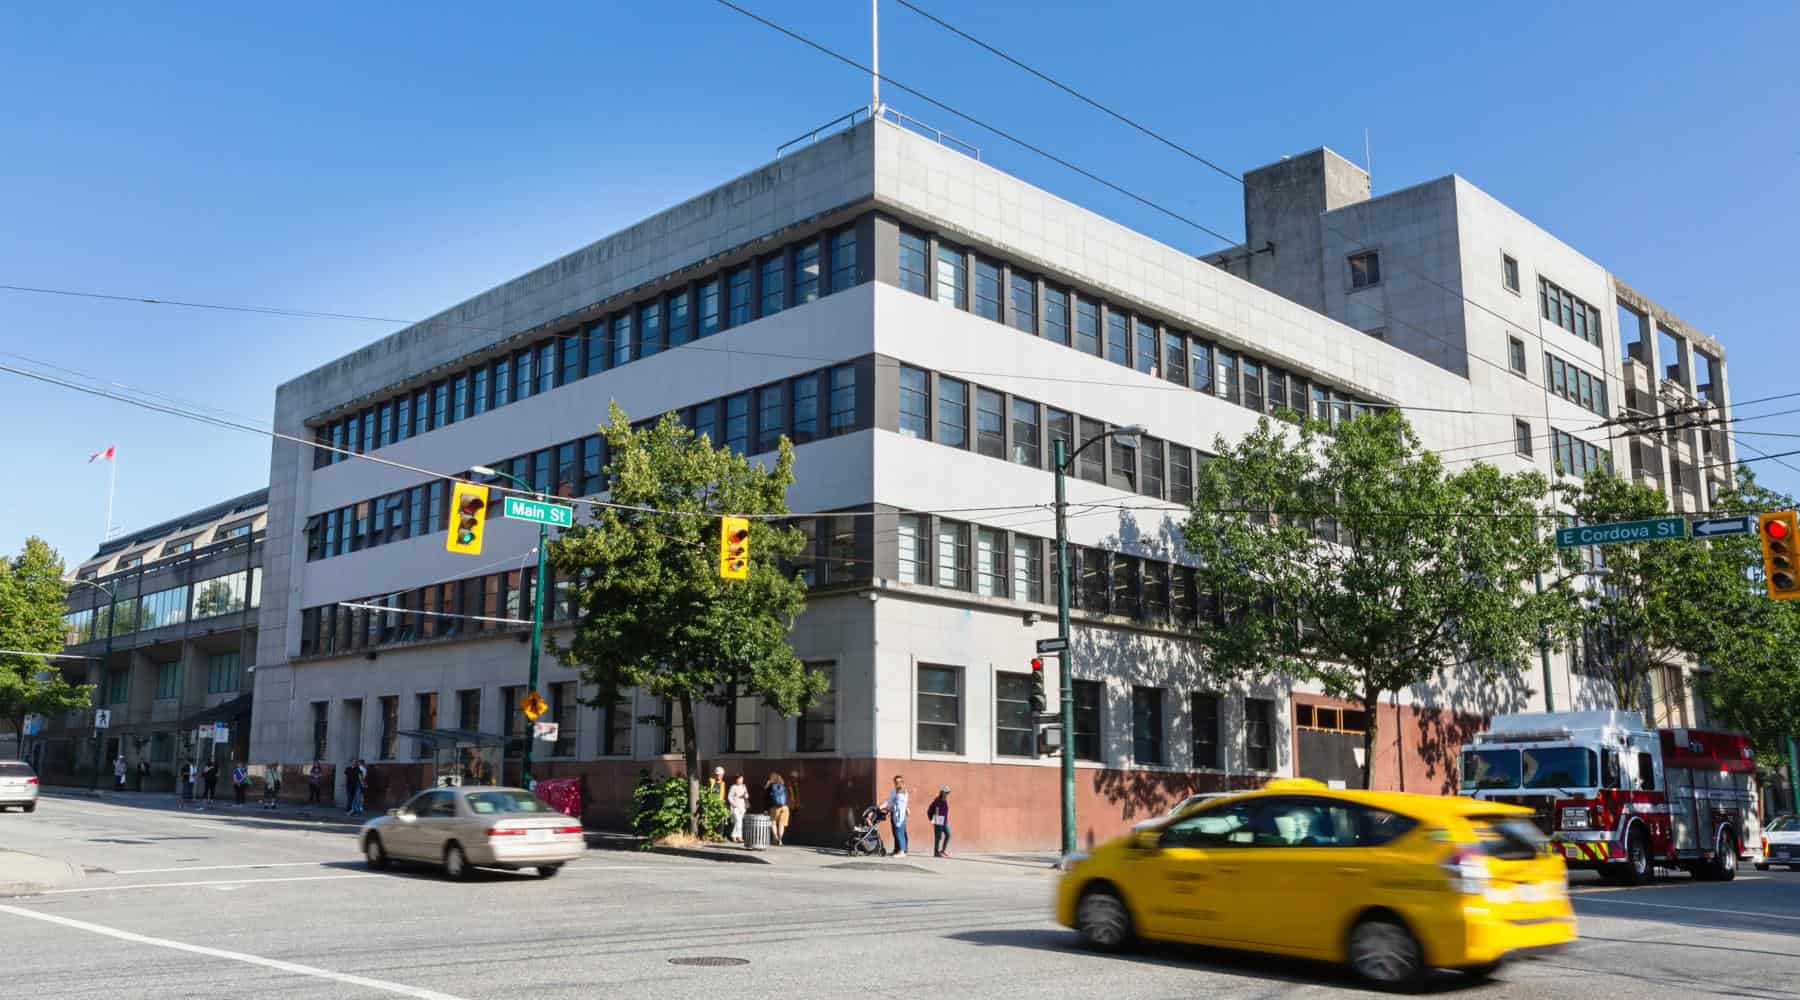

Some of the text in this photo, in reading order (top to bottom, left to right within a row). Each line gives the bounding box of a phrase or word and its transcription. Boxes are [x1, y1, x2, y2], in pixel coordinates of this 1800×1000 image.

[512, 502, 565, 522] Main St
[1563, 521, 1676, 544] E Cordova St
